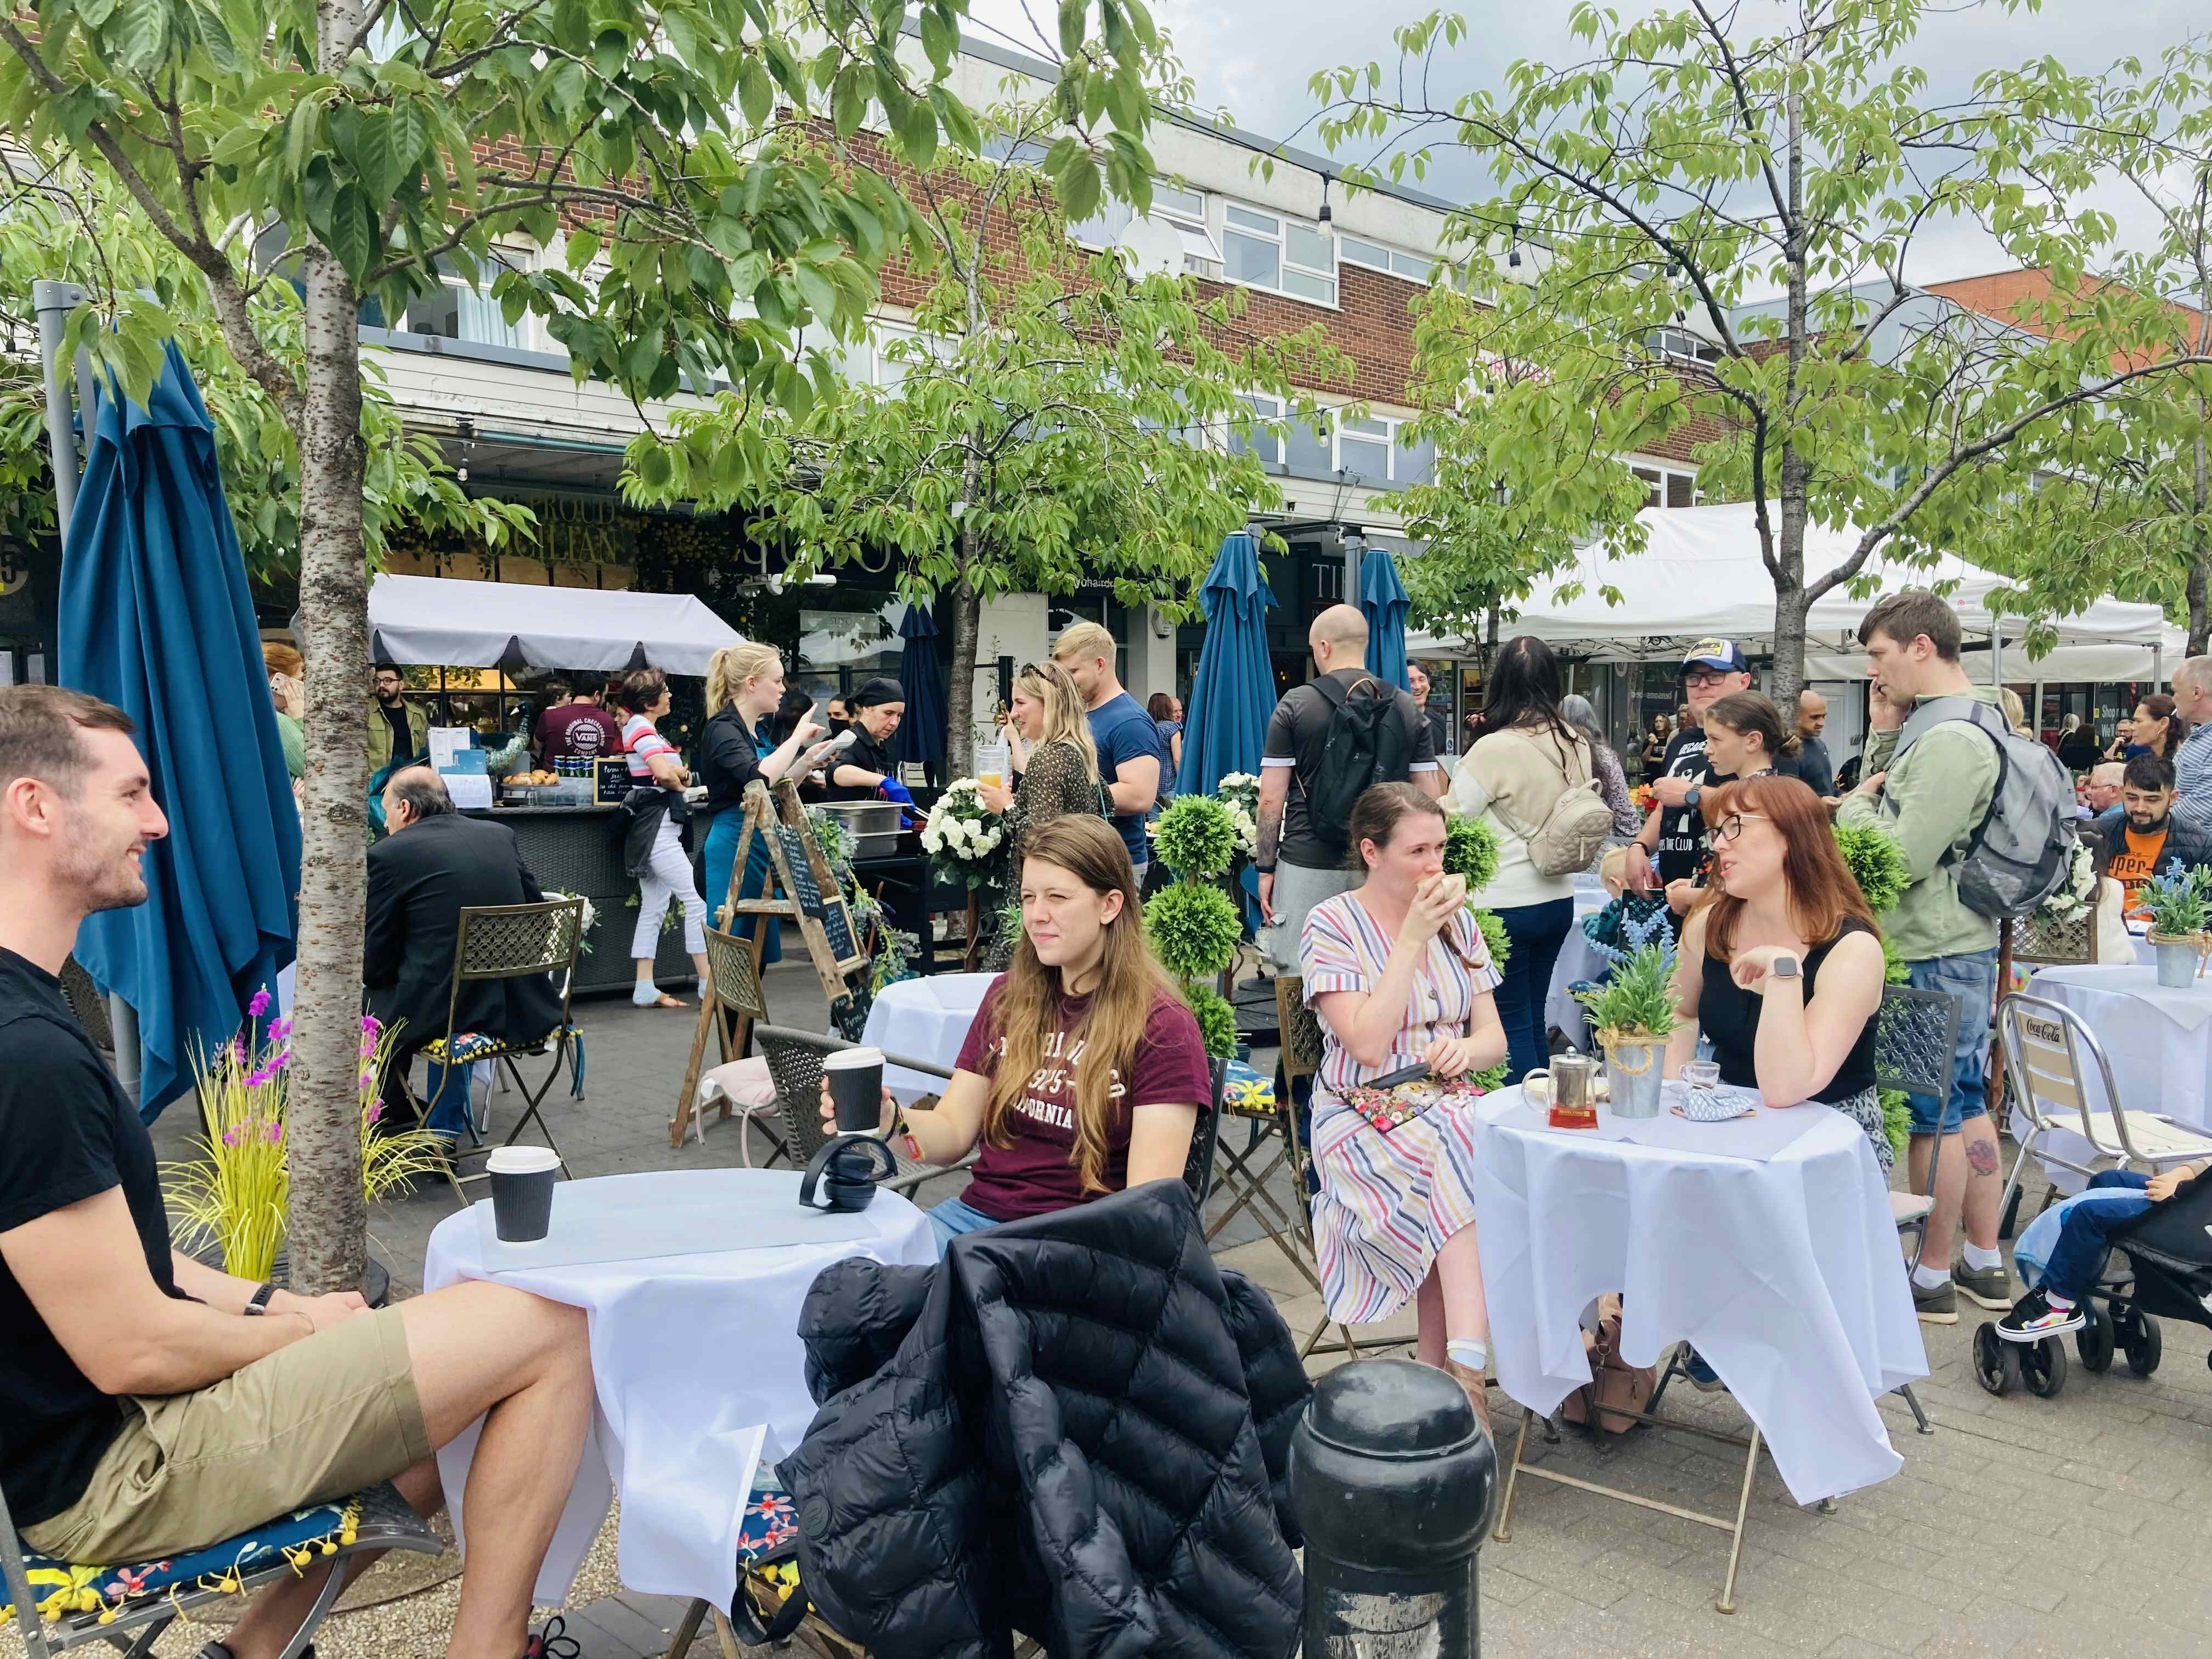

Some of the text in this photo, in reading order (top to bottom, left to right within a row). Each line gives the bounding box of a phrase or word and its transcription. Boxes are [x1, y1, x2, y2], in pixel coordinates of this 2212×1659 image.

[1312, 563, 1346, 599] TI
[2102, 704, 2115, 720] Shop
[575, 732, 598, 742] VANS
[1675, 837, 1693, 851] CLUB
[2109, 856, 2152, 876] uper-
[2027, 1018, 2061, 1043] Coca-Cola
